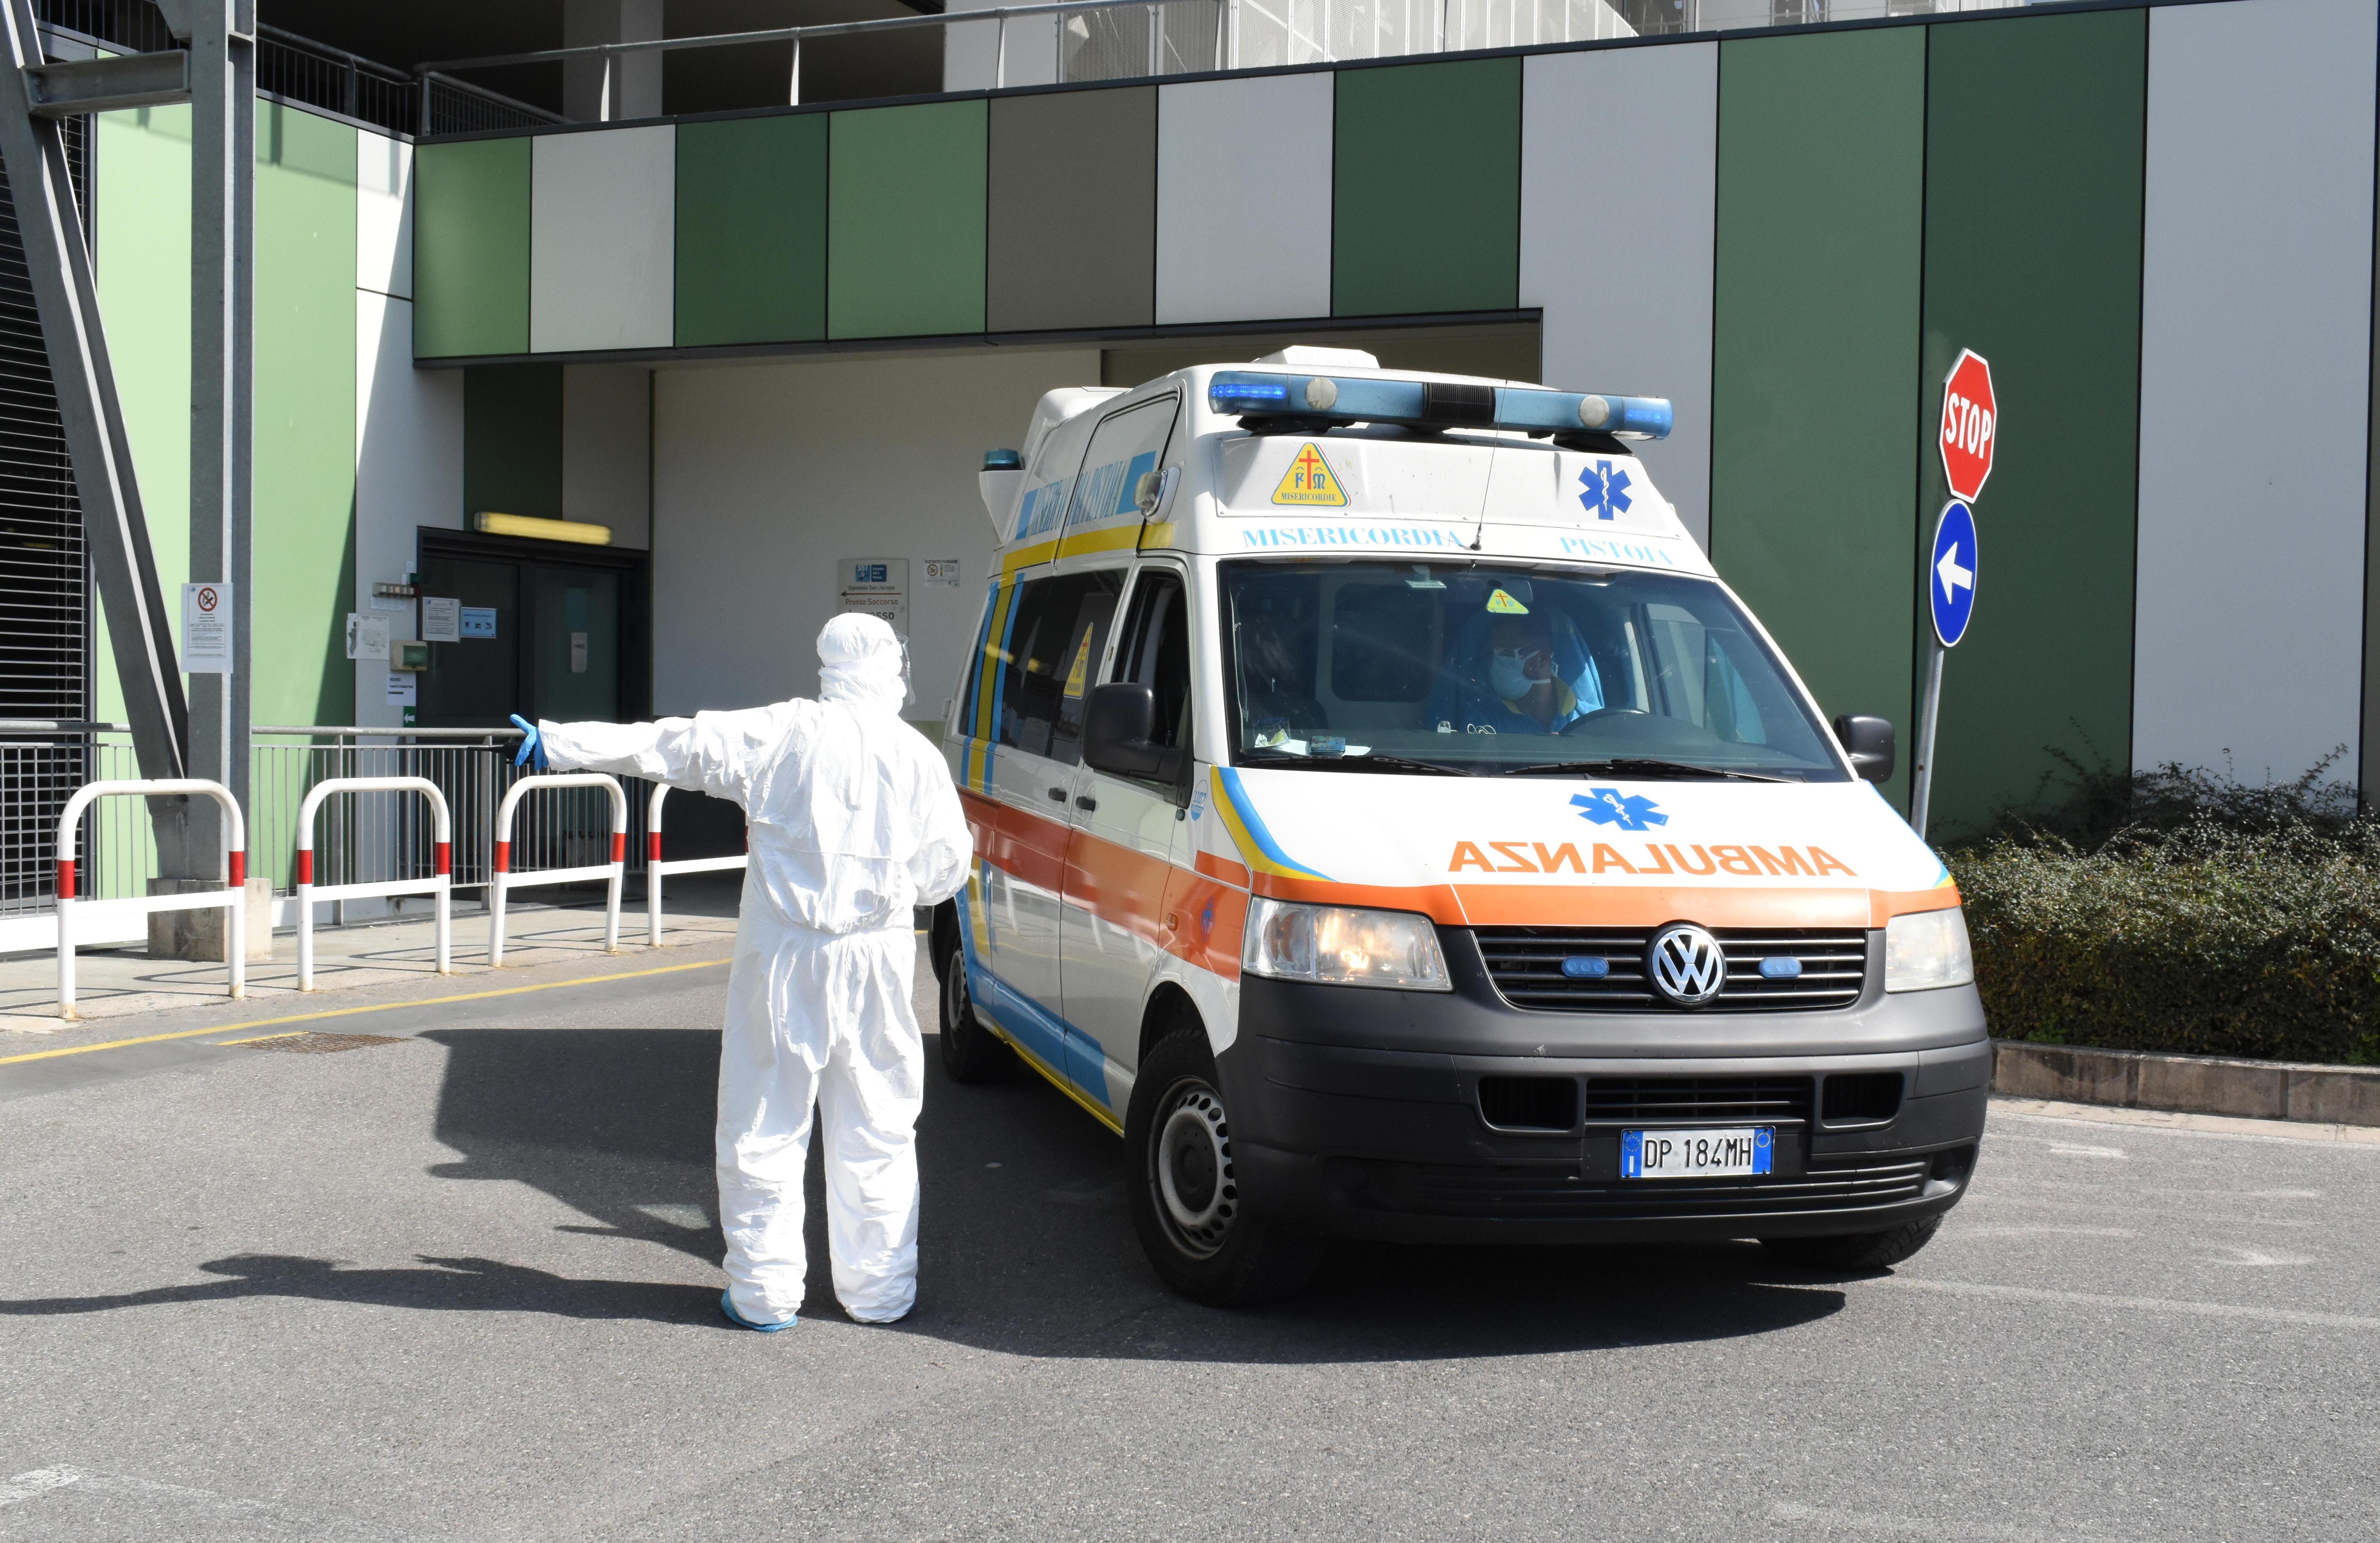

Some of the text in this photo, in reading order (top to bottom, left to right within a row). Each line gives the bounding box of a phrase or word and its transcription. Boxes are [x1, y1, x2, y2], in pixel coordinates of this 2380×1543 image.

[1945, 392, 1992, 459] STOP
[1281, 492, 1337, 502] MISERICORDIE
[1241, 527, 1674, 565] MISERICORDIA PISTOIA
[1193, 791, 1207, 804] 1107
[1652, 929, 1723, 1002] VW
[1644, 1136, 1753, 1168] DP 184MH
